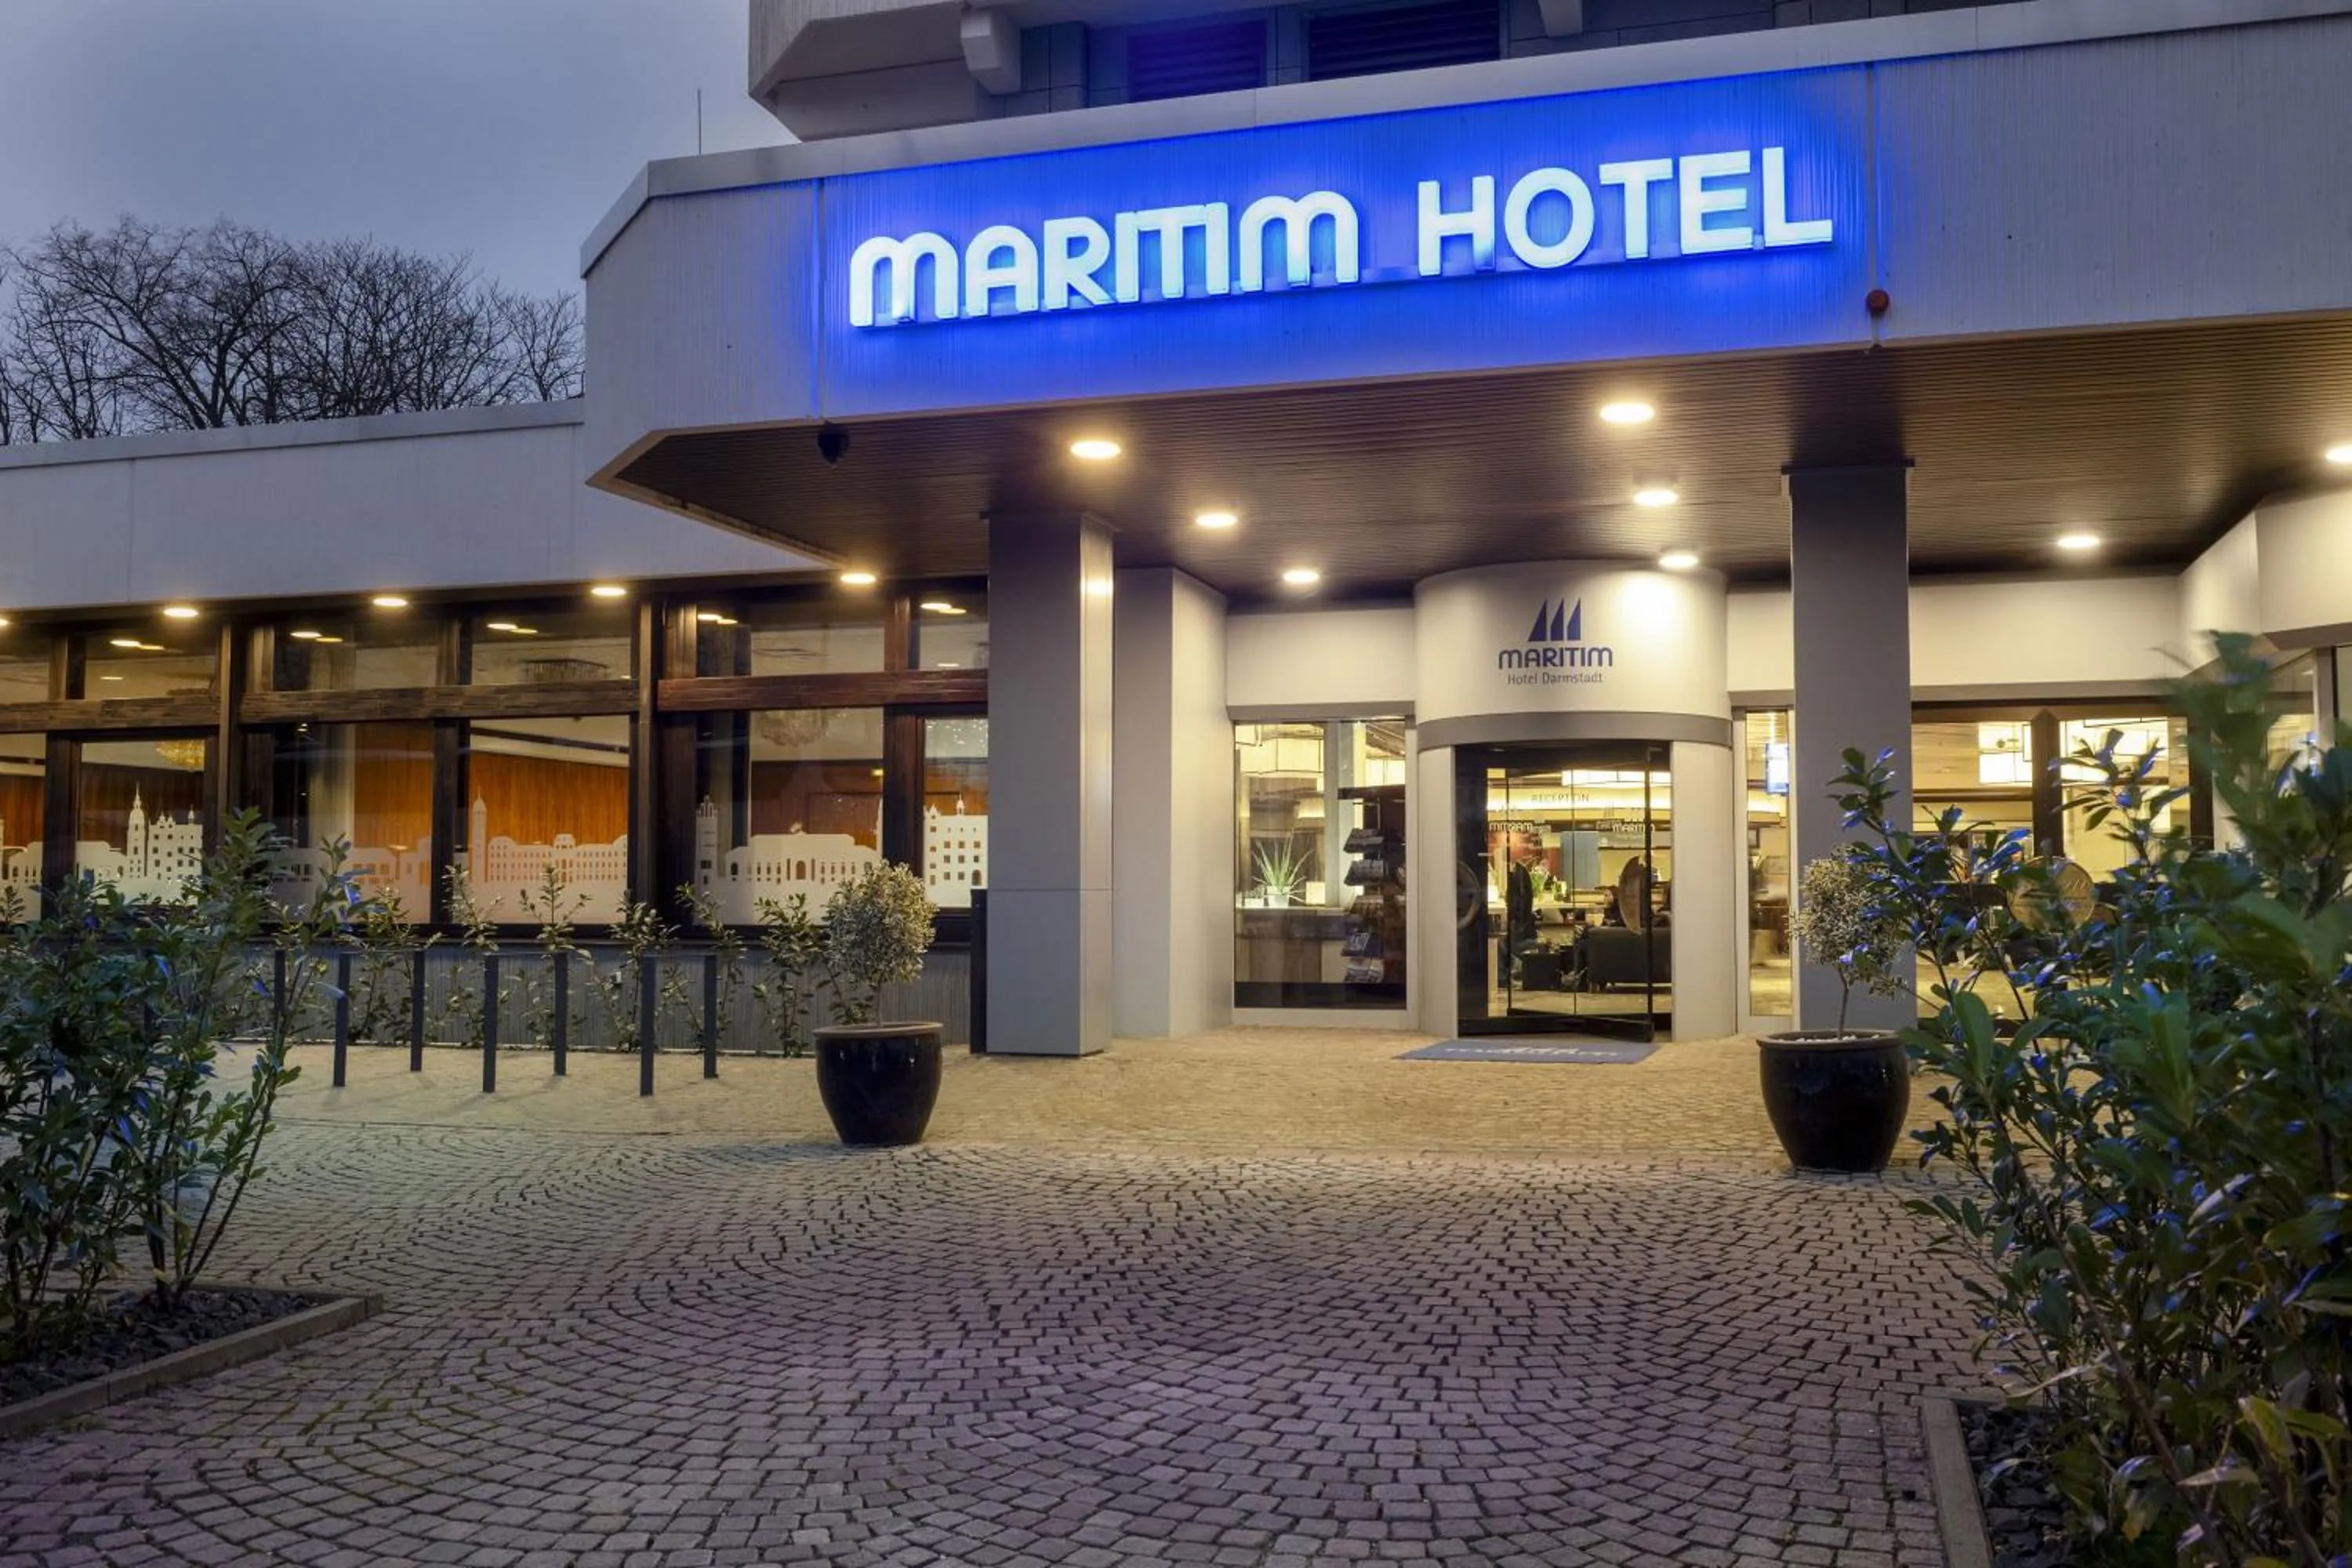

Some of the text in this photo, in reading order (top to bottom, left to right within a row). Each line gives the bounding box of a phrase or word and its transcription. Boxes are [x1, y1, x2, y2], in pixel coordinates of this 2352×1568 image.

[850, 147, 1834, 328] MARITIM HOTEL
[1498, 647, 1613, 670] MARITIM
[1508, 671, 1603, 685] Hotel Darmstadt
[1531, 792, 1590, 804] RECEPTON
